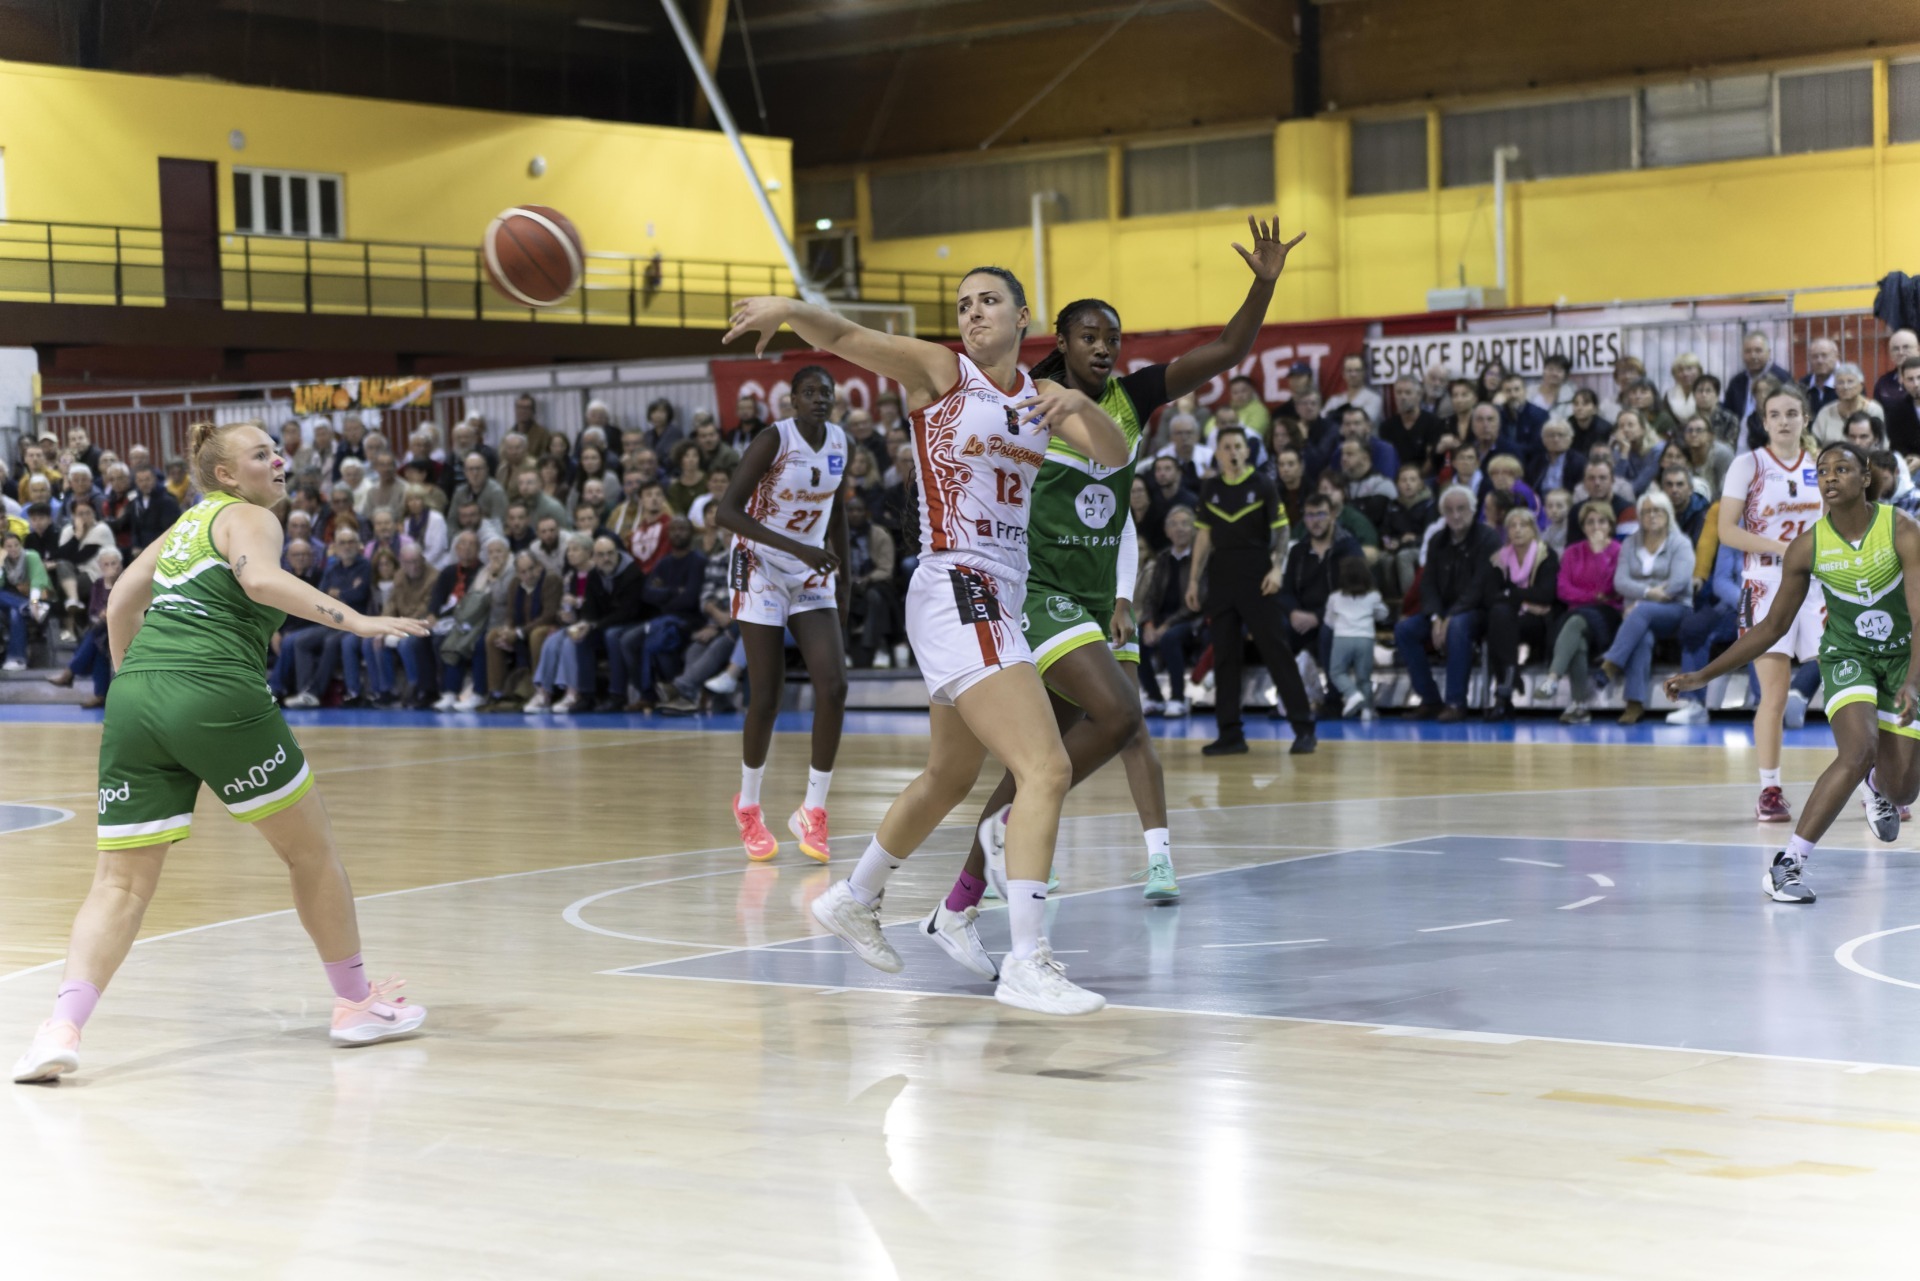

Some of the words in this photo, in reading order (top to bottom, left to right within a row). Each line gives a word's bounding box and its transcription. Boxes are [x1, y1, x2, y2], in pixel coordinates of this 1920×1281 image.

[1371, 343, 1450, 378] ESPACE
[1462, 333, 1619, 374] PARTENAIRES
[961, 434, 984, 458] Le
[994, 467, 1023, 507] 12
[786, 510, 823, 534] 27
[1779, 520, 1806, 542] 21
[1856, 578, 1874, 604] 5
[1860, 616, 1885, 629] MT
[223, 744, 287, 796] nhood
